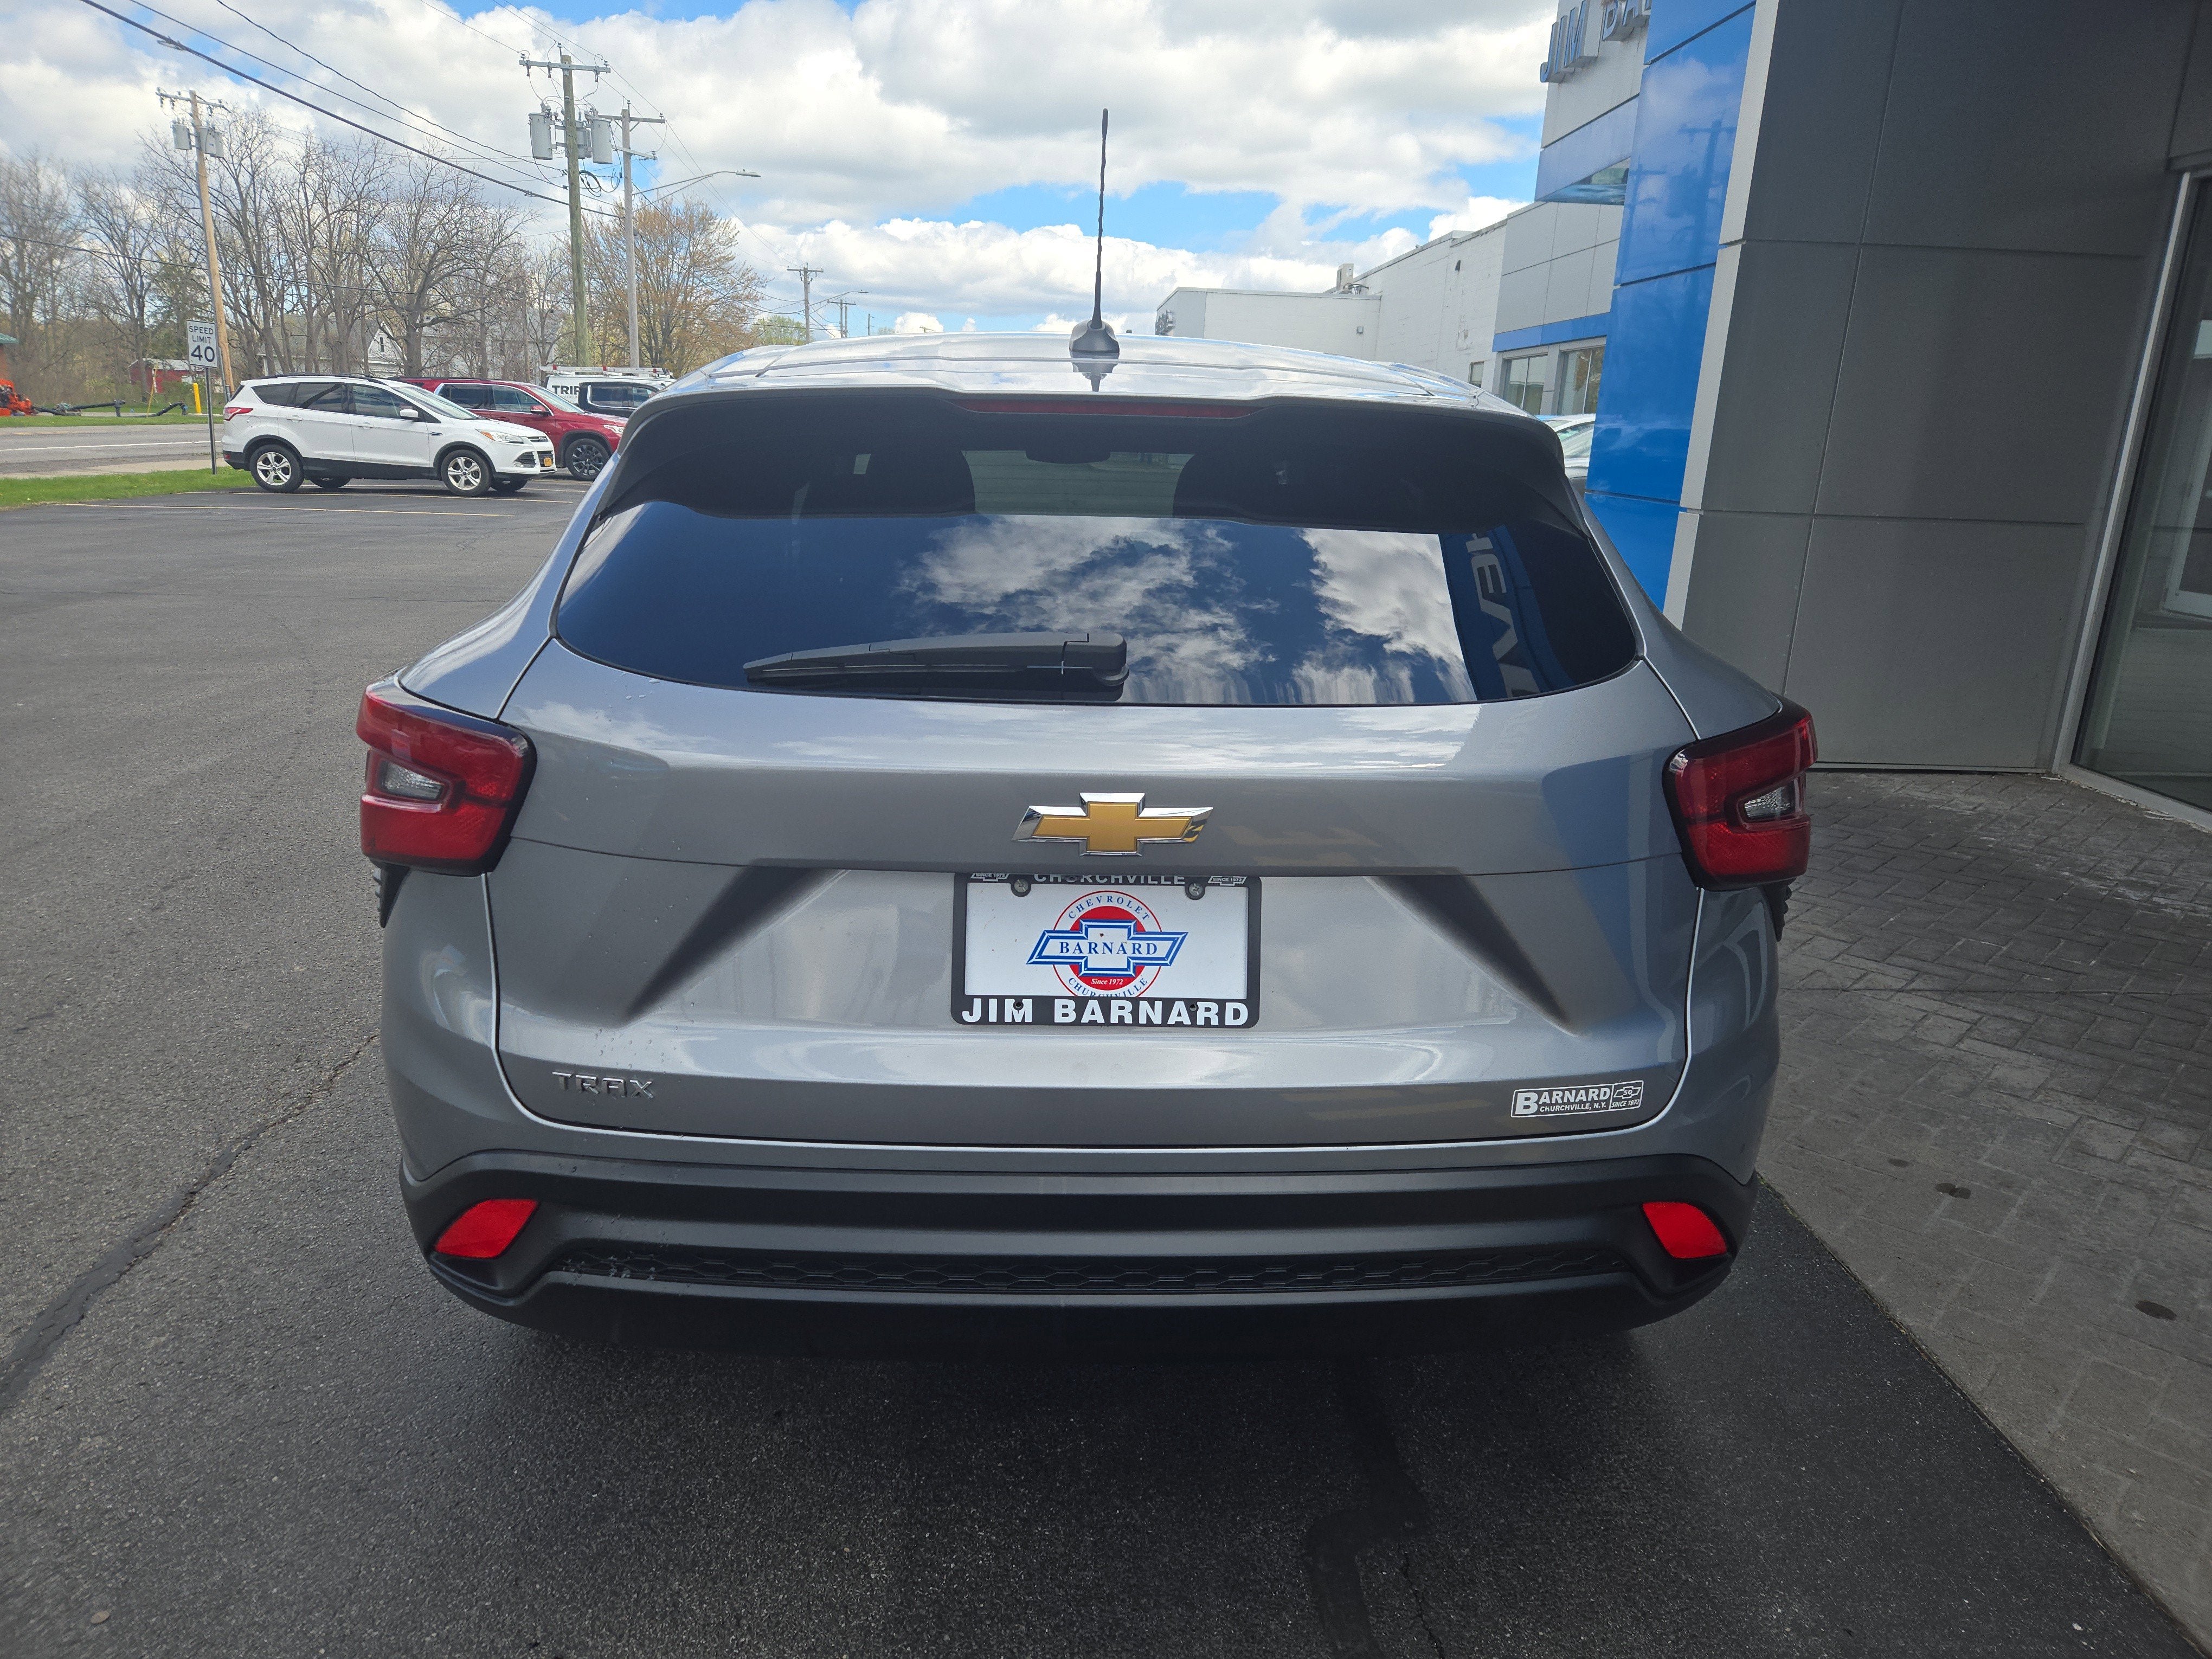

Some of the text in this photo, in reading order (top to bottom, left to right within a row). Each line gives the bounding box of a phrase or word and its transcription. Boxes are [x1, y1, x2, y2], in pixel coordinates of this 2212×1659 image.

[189, 326, 214, 335] SPEED
[192, 335, 211, 344] LIMIT
[191, 345, 215, 362] 40
[1069, 895, 1150, 920] CHEVROLET
[1059, 942, 1158, 955] BARNARD
[962, 998, 1249, 1026] JIM BARNARD
[552, 1071, 654, 1099] TRAX
[1515, 1088, 1610, 1115] BARNARD
[1540, 1101, 1606, 1113] CHURCHVILLE, N.Y.
[1611, 1100, 1628, 1108] SINCE
